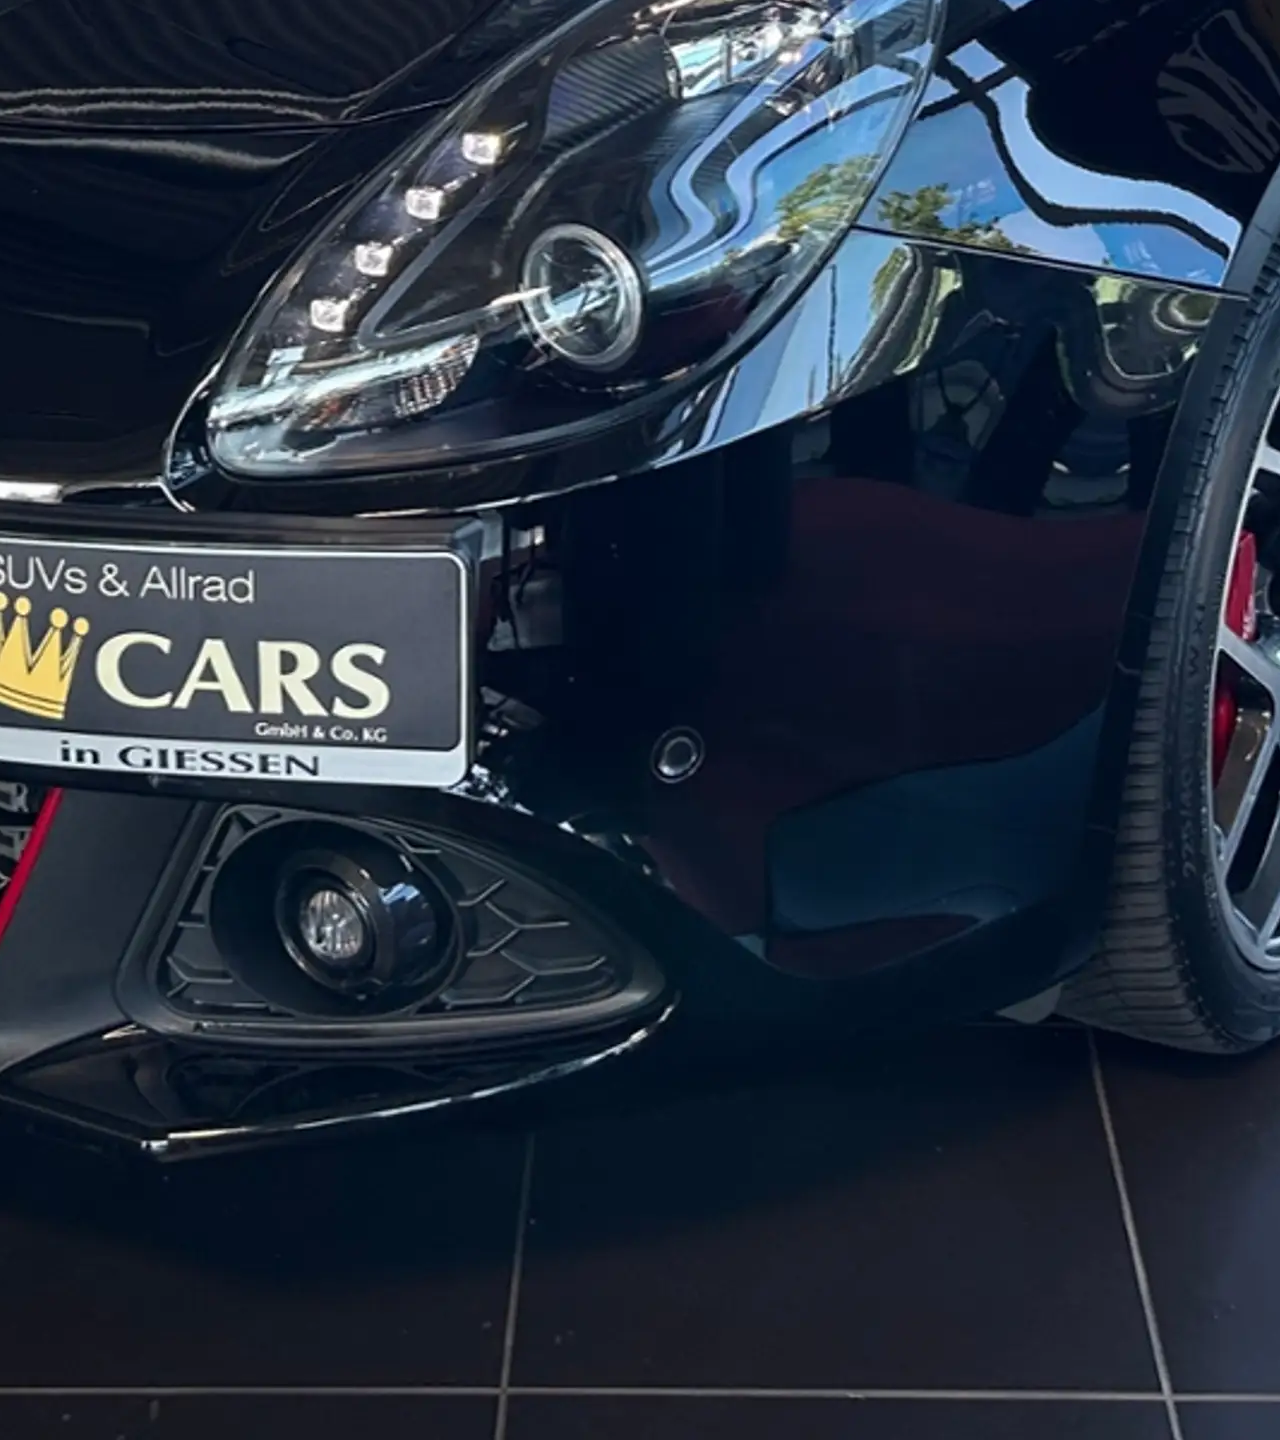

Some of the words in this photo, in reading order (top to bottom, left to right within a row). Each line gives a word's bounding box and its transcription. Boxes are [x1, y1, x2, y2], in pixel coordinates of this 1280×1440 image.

[97, 562, 130, 598] &
[138, 564, 255, 604] Allrad
[94, 631, 391, 720] CARS
[254, 721, 309, 739] GmbH
[312, 725, 325, 740] &
[329, 724, 360, 742] Co.
[362, 727, 389, 744] KG
[59, 740, 101, 766] in
[117, 744, 321, 778] GIESSEN
